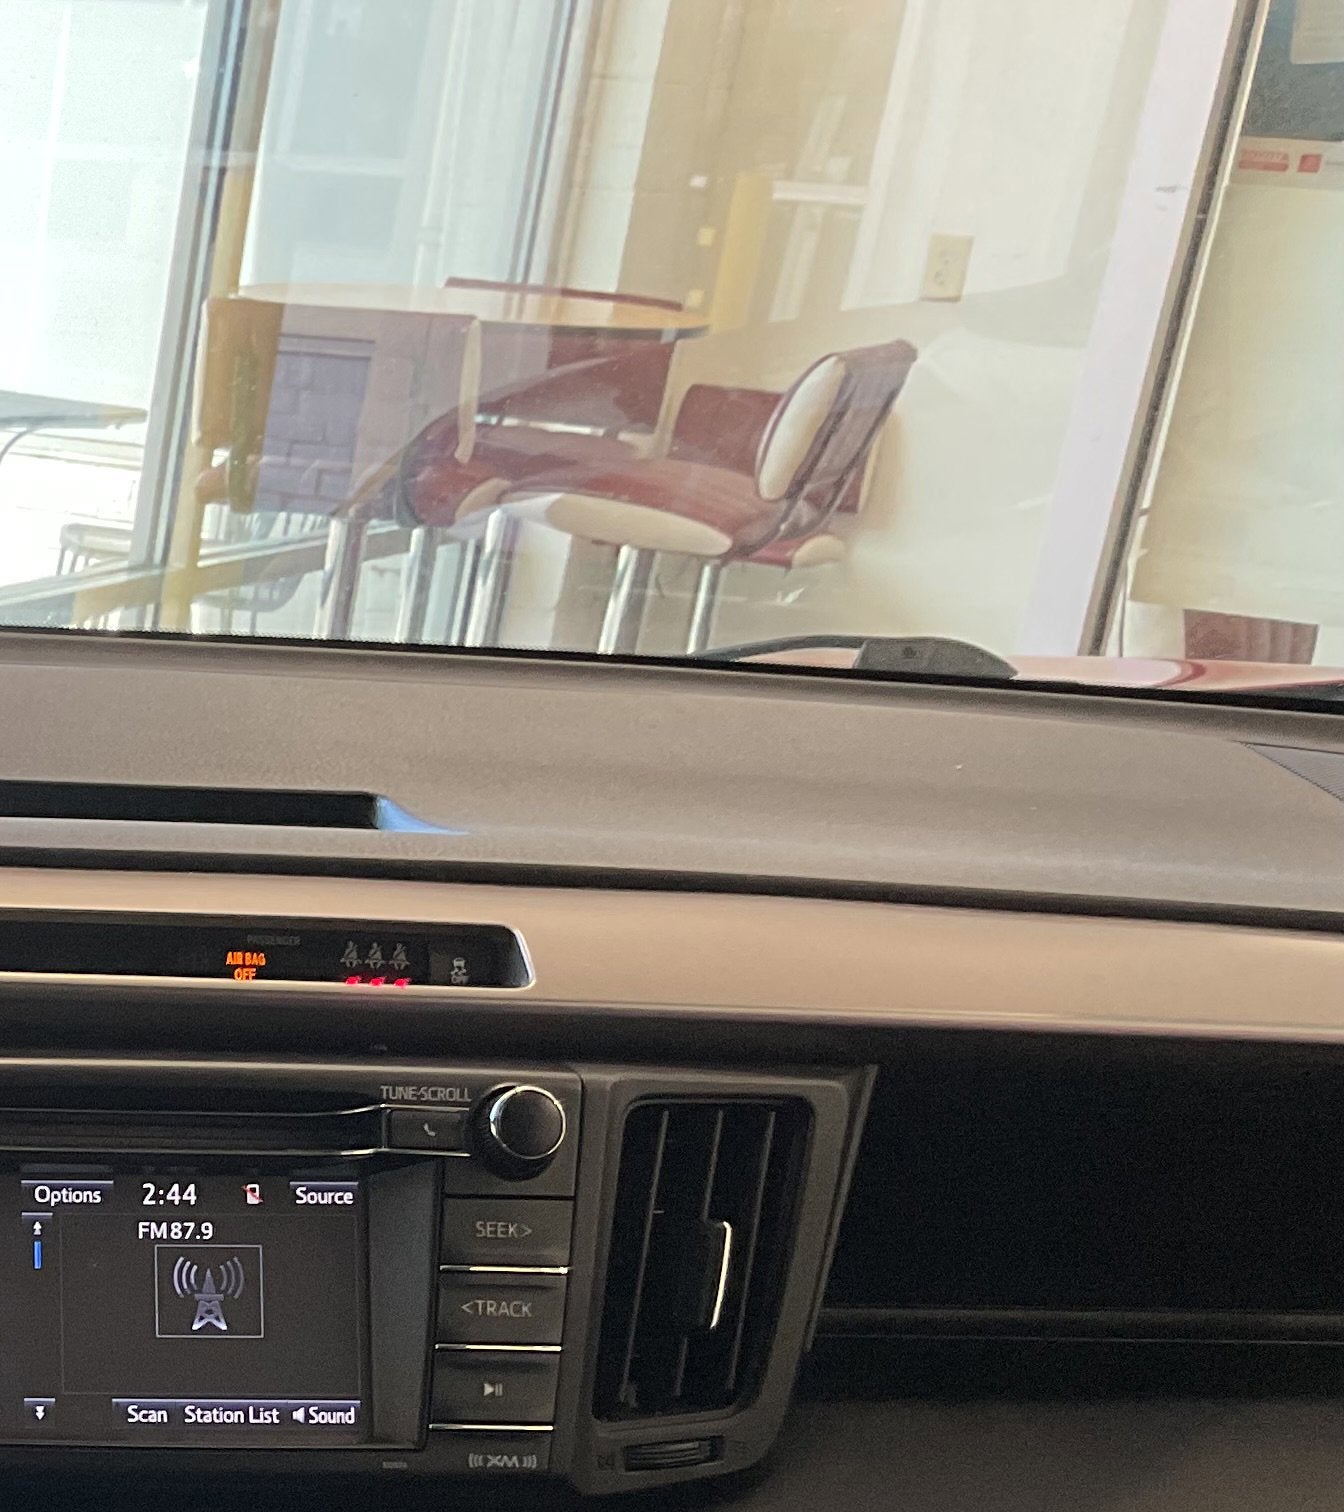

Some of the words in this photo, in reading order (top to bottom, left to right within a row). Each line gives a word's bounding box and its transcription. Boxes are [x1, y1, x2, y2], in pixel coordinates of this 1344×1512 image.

[234, 967, 256, 981] OFF
[34, 1186, 102, 1206] Options
[142, 1183, 198, 1205] 2:44
[295, 1187, 354, 1206] Source
[127, 1406, 168, 1424] Scan
[184, 1407, 245, 1424] Station
[249, 1407, 280, 1425] List
[309, 1407, 355, 1425] Sound
